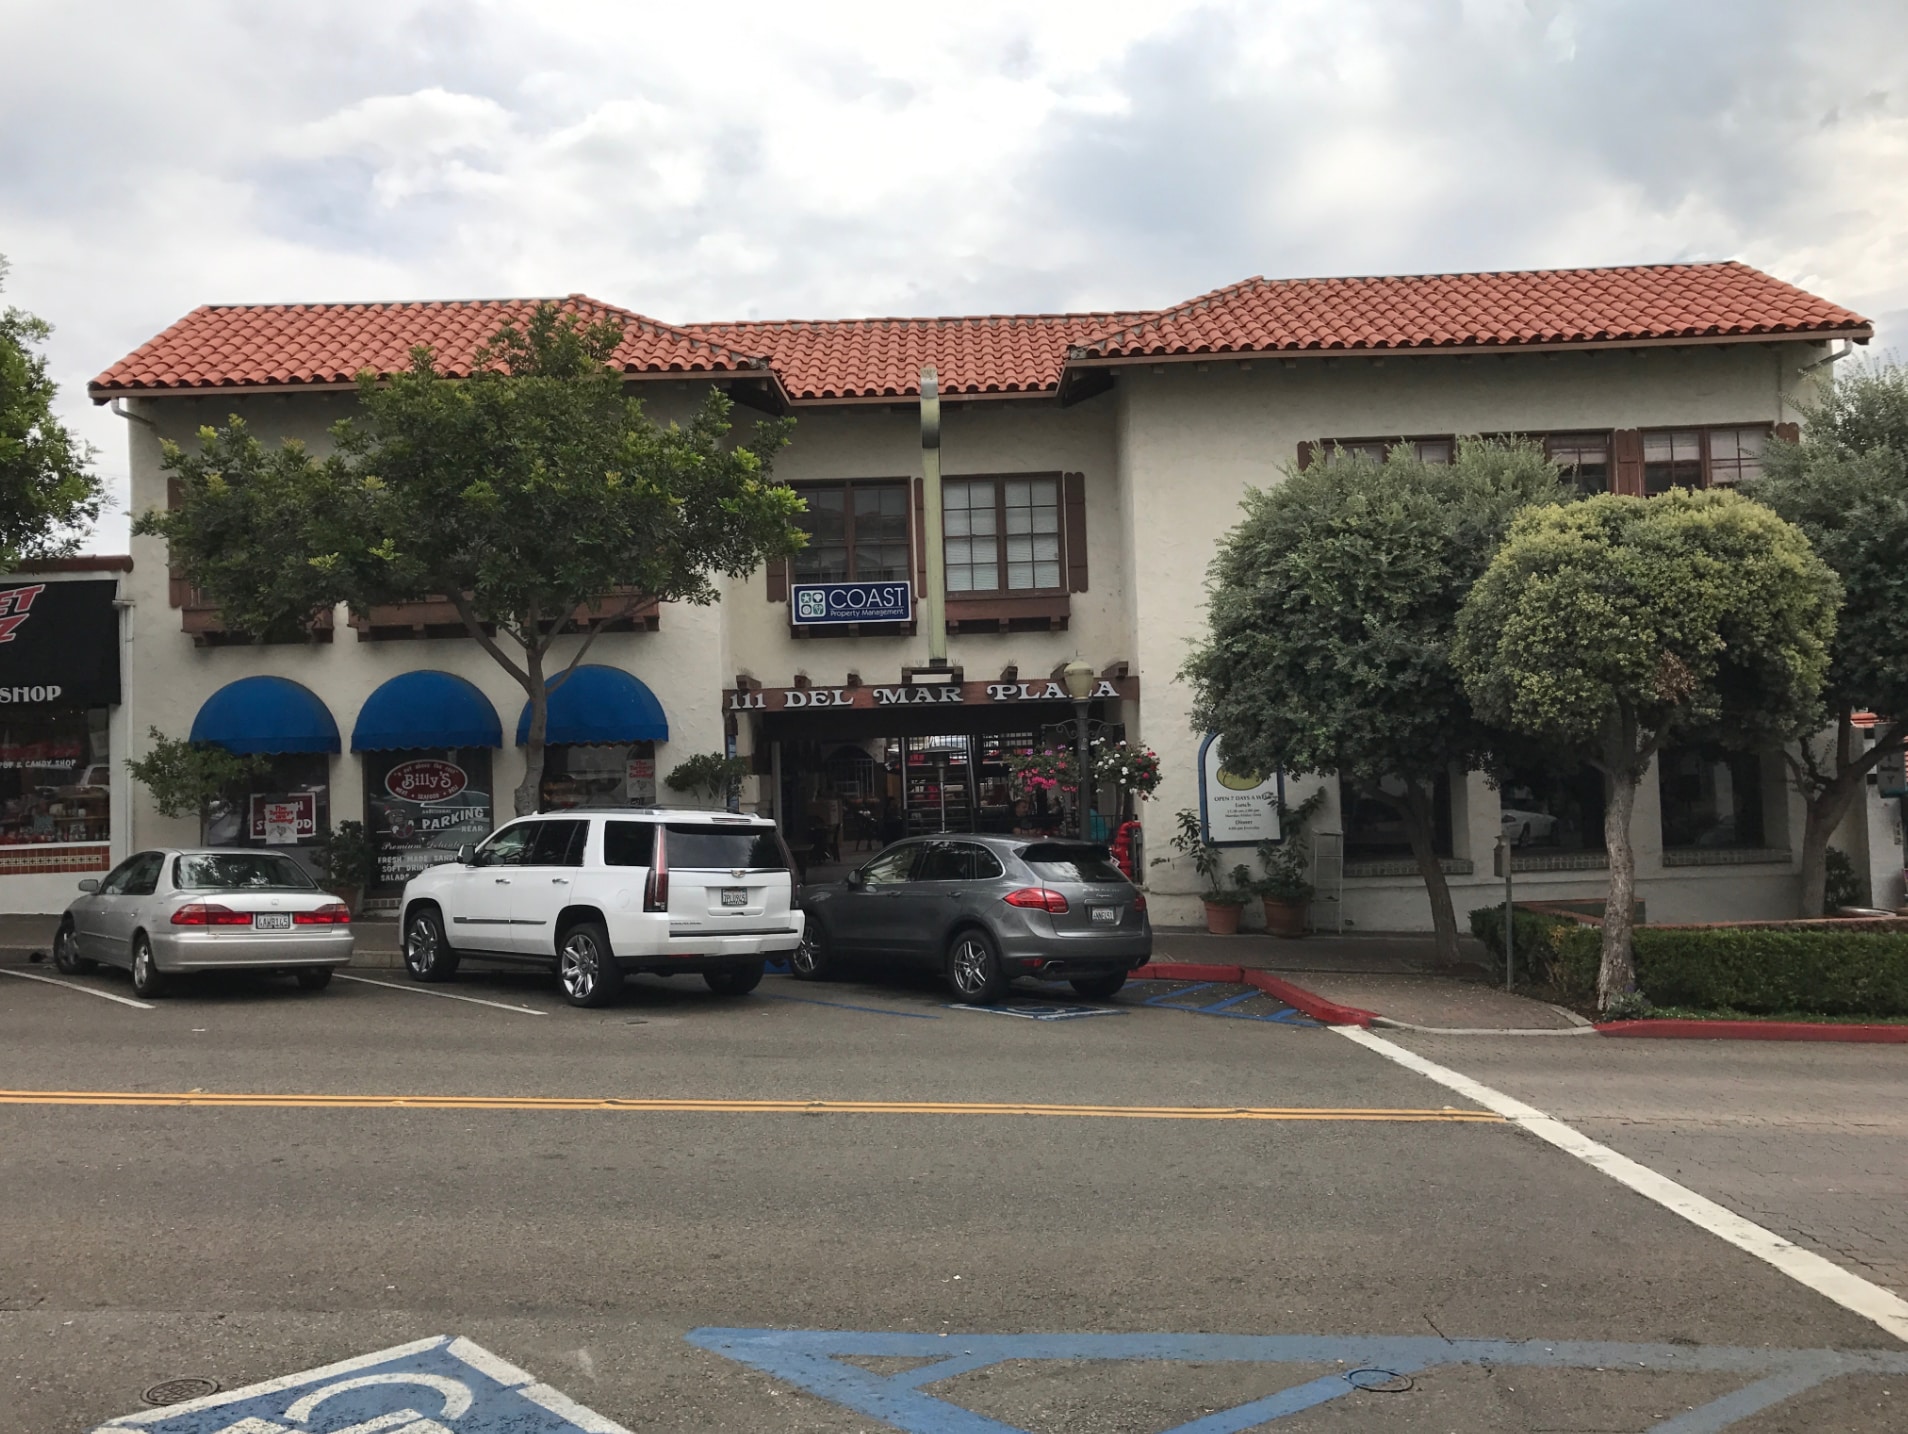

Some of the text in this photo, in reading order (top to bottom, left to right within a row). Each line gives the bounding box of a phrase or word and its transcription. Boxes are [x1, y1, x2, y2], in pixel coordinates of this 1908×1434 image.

[829, 587, 904, 608] COAST
[830, 608, 904, 618] Property Management
[0, 686, 62, 703] SHOP
[729, 681, 1120, 710] 111 DEL MAR PLAA
[25, 760, 52, 768] CANDY
[55, 759, 77, 767] SHOP
[421, 807, 484, 830] PARKING
[461, 825, 484, 833] REAR
[381, 841, 422, 850] Premium
[377, 856, 402, 864] FRESH
[382, 865, 400, 873] SOFT
